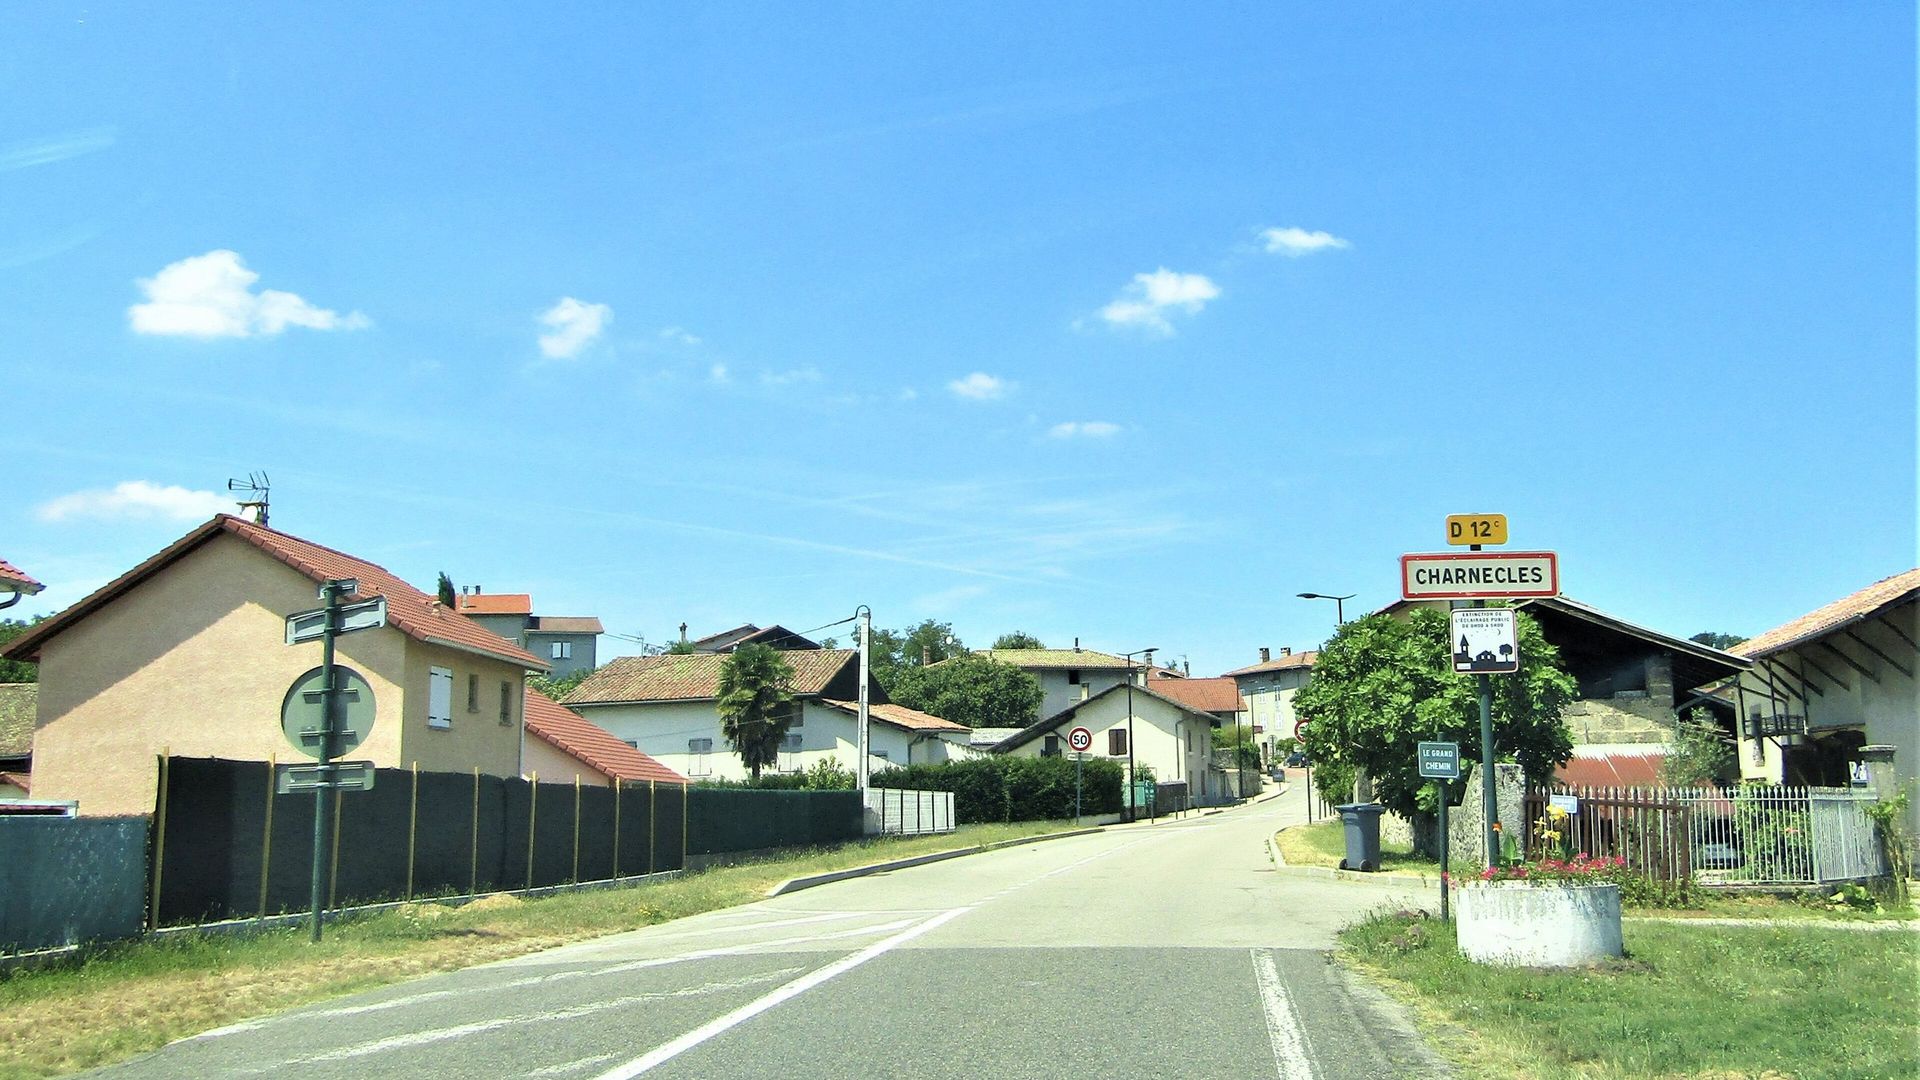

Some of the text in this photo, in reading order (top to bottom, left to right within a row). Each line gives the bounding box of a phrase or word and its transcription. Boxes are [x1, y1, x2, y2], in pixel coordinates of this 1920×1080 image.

[1451, 522, 1462, 538] D
[1415, 566, 1543, 585] CHARNECLES
[1073, 734, 1088, 745] 50
[1425, 762, 1451, 770] CHEMIN
